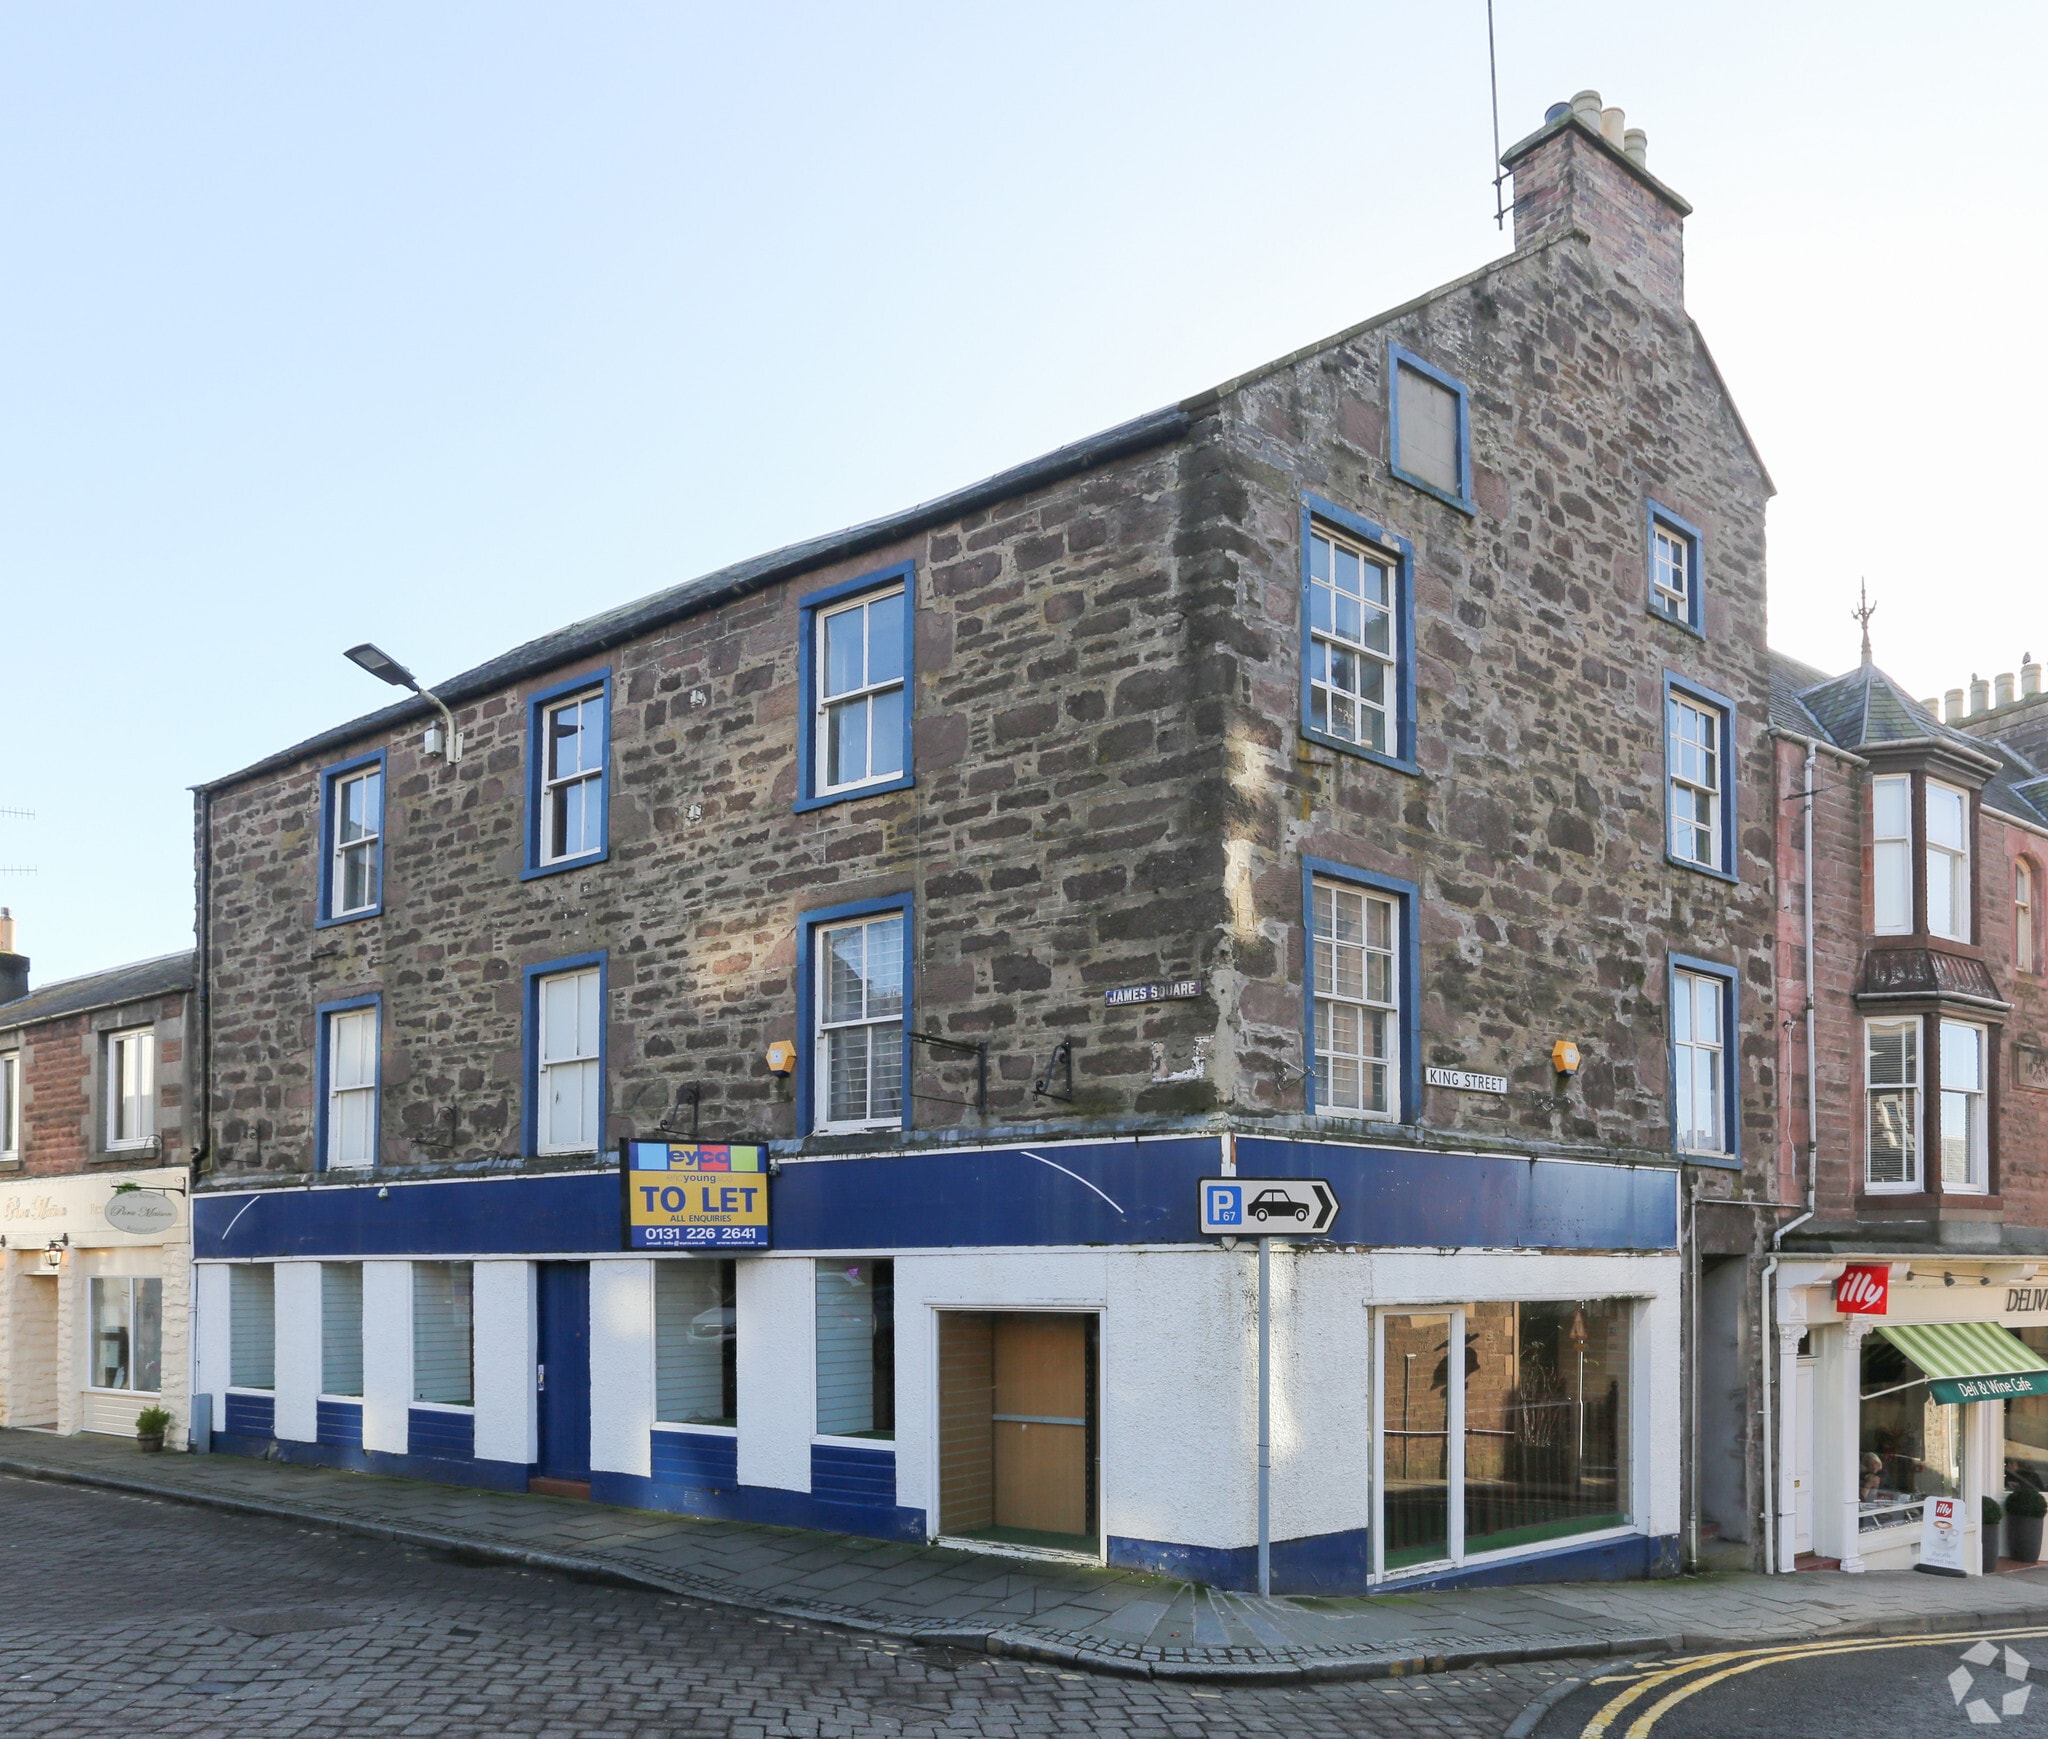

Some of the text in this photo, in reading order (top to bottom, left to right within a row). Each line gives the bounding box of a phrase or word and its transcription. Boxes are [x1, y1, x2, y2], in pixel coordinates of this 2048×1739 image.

[1110, 982, 1196, 1003] JAMES SQUARE
[1430, 1069, 1503, 1091] KING STREET
[668, 1150, 730, 1165] eyco
[639, 1186, 758, 1213] TO LET
[1213, 1190, 1236, 1221] P 67
[669, 1214, 732, 1223] ALL ENQUIRIES
[645, 1227, 756, 1239] 0131 226 2641
[1839, 1272, 1884, 1310] illy
[1957, 1376, 2033, 1397] Deli & Wine Cafe
[1936, 1503, 1952, 1517] illy
